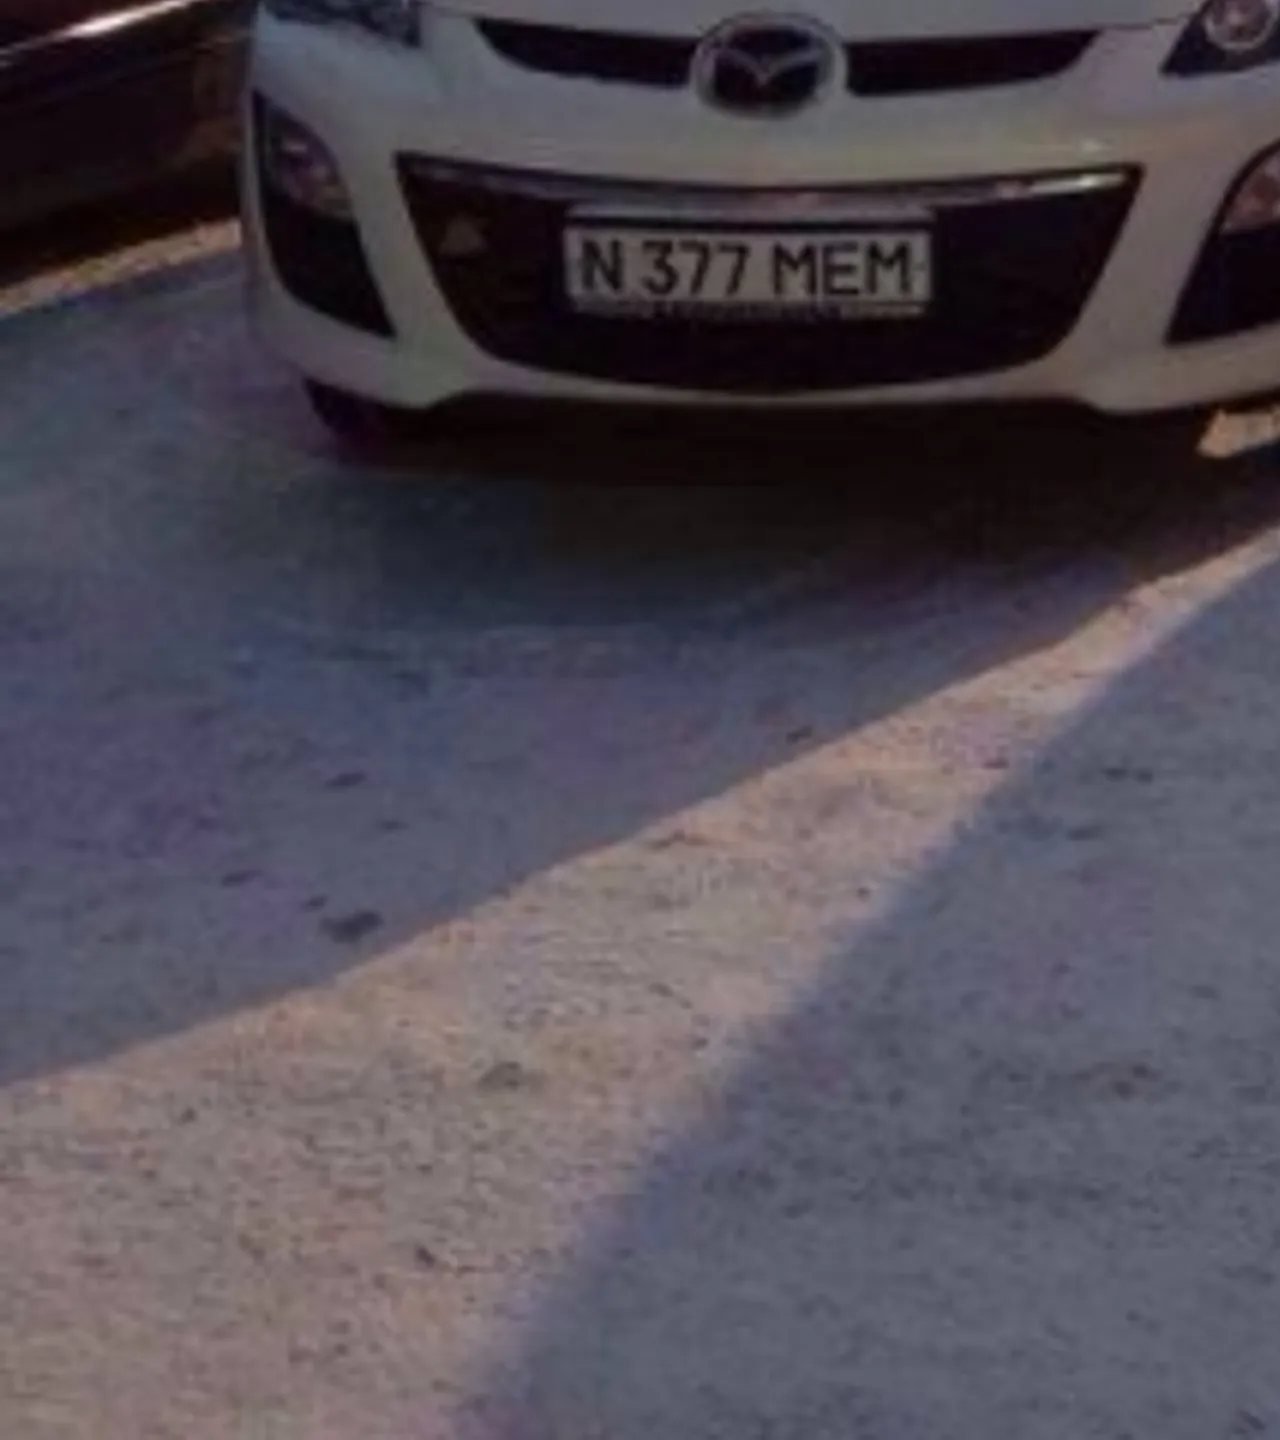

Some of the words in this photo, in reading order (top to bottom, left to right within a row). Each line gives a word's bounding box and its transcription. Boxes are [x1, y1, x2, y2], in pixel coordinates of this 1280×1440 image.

[580, 238, 624, 292] N
[641, 240, 751, 295] 377
[771, 241, 912, 296] MEM
